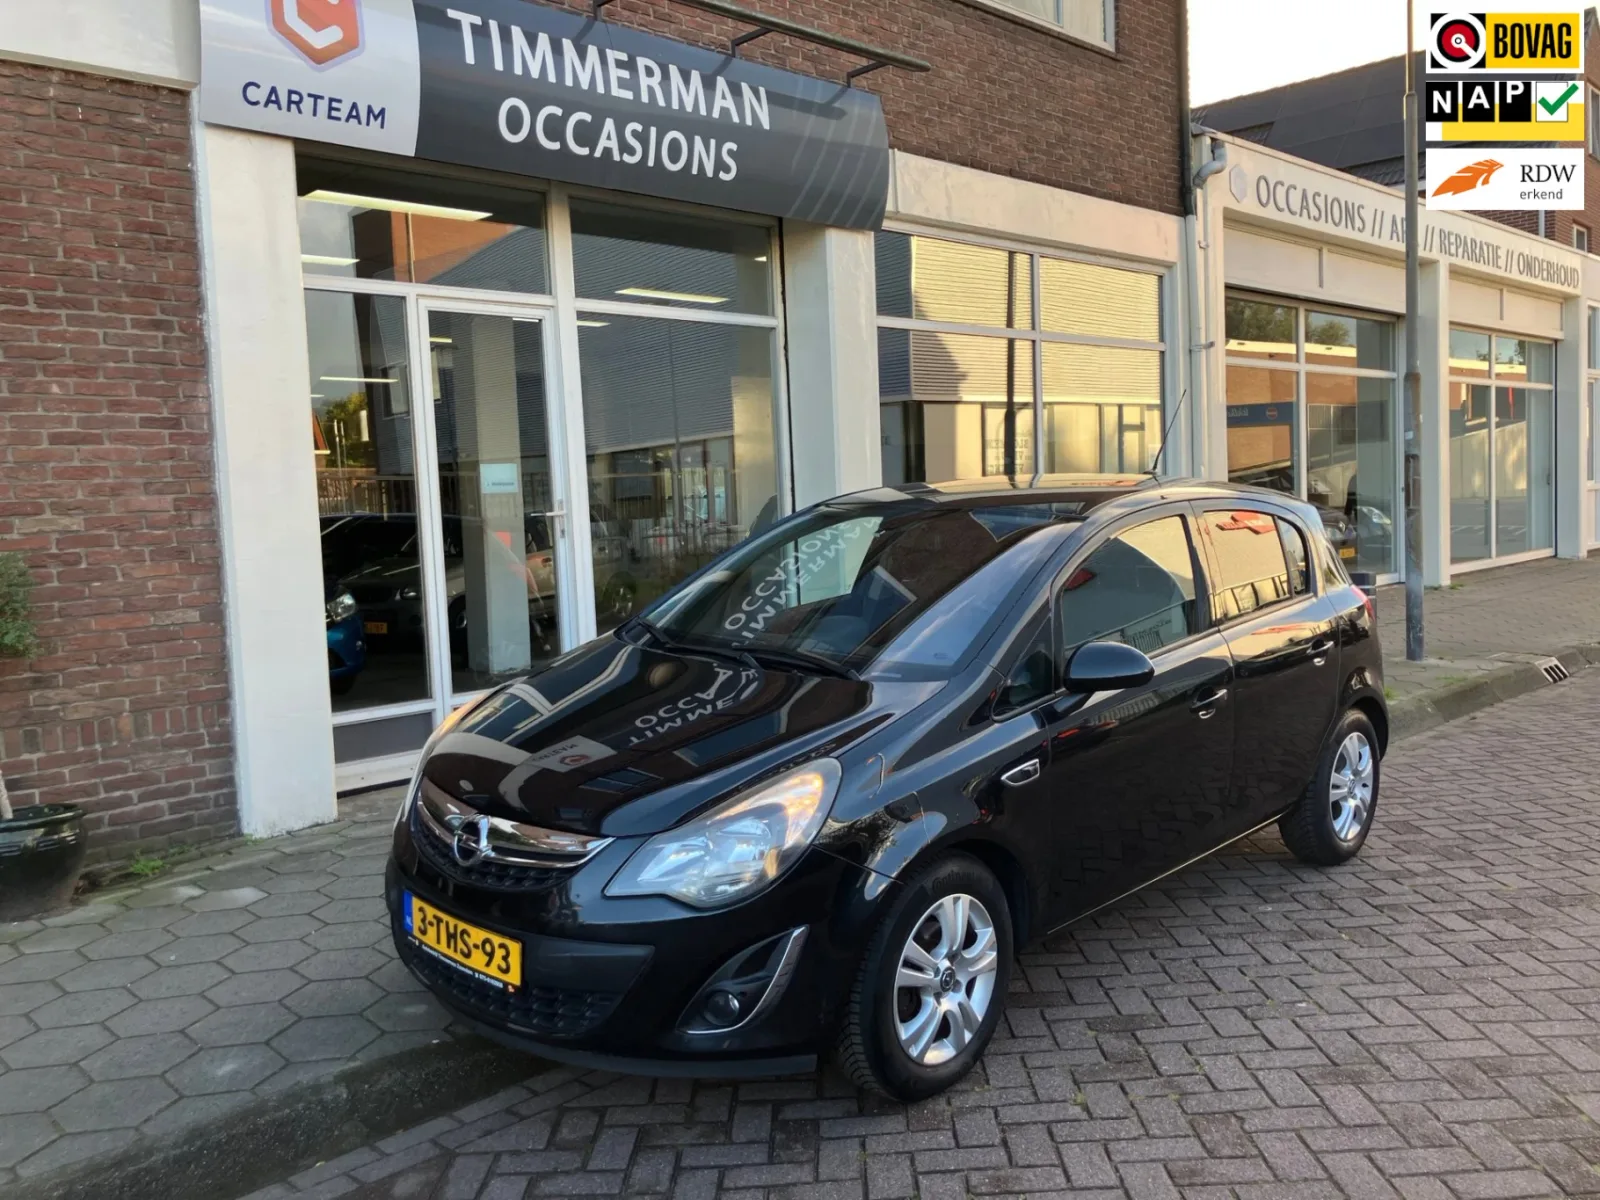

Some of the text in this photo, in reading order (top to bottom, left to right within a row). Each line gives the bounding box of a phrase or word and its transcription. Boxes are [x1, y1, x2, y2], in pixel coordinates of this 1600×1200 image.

[241, 81, 387, 130] CARTEAM
[446, 8, 770, 130] TIMMERMAN
[498, 97, 738, 182] OCCASIONS
[1256, 174, 1366, 233] OCCASIONS
[1439, 228, 1502, 272] REPARATIE
[1517, 251, 1580, 289] ONDERHOUD
[418, 906, 511, 975] 3-THS-93
